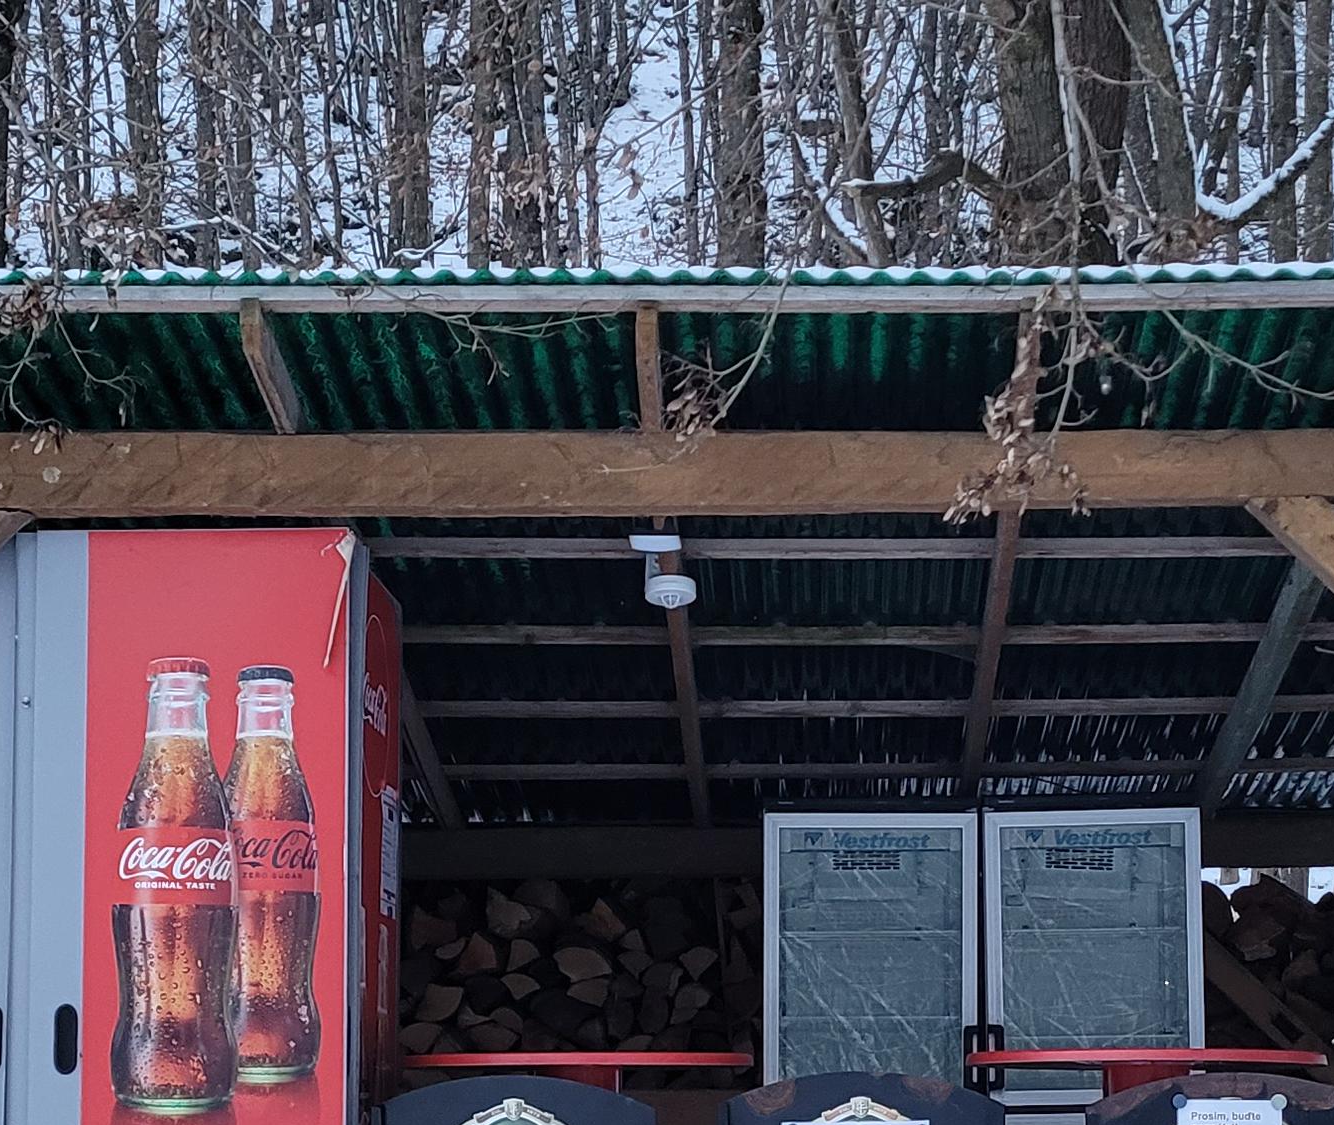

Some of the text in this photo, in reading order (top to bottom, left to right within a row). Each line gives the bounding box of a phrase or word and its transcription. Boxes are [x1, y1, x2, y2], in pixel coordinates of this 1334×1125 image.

[833, 832, 930, 849] Vestfrost
[1053, 829, 1153, 846] Vestfrost
[118, 836, 233, 882] Coca-Cola
[134, 880, 216, 890] ORIGINAL TASTE
[1191, 1111, 1261, 1122] Prosím, buďte
